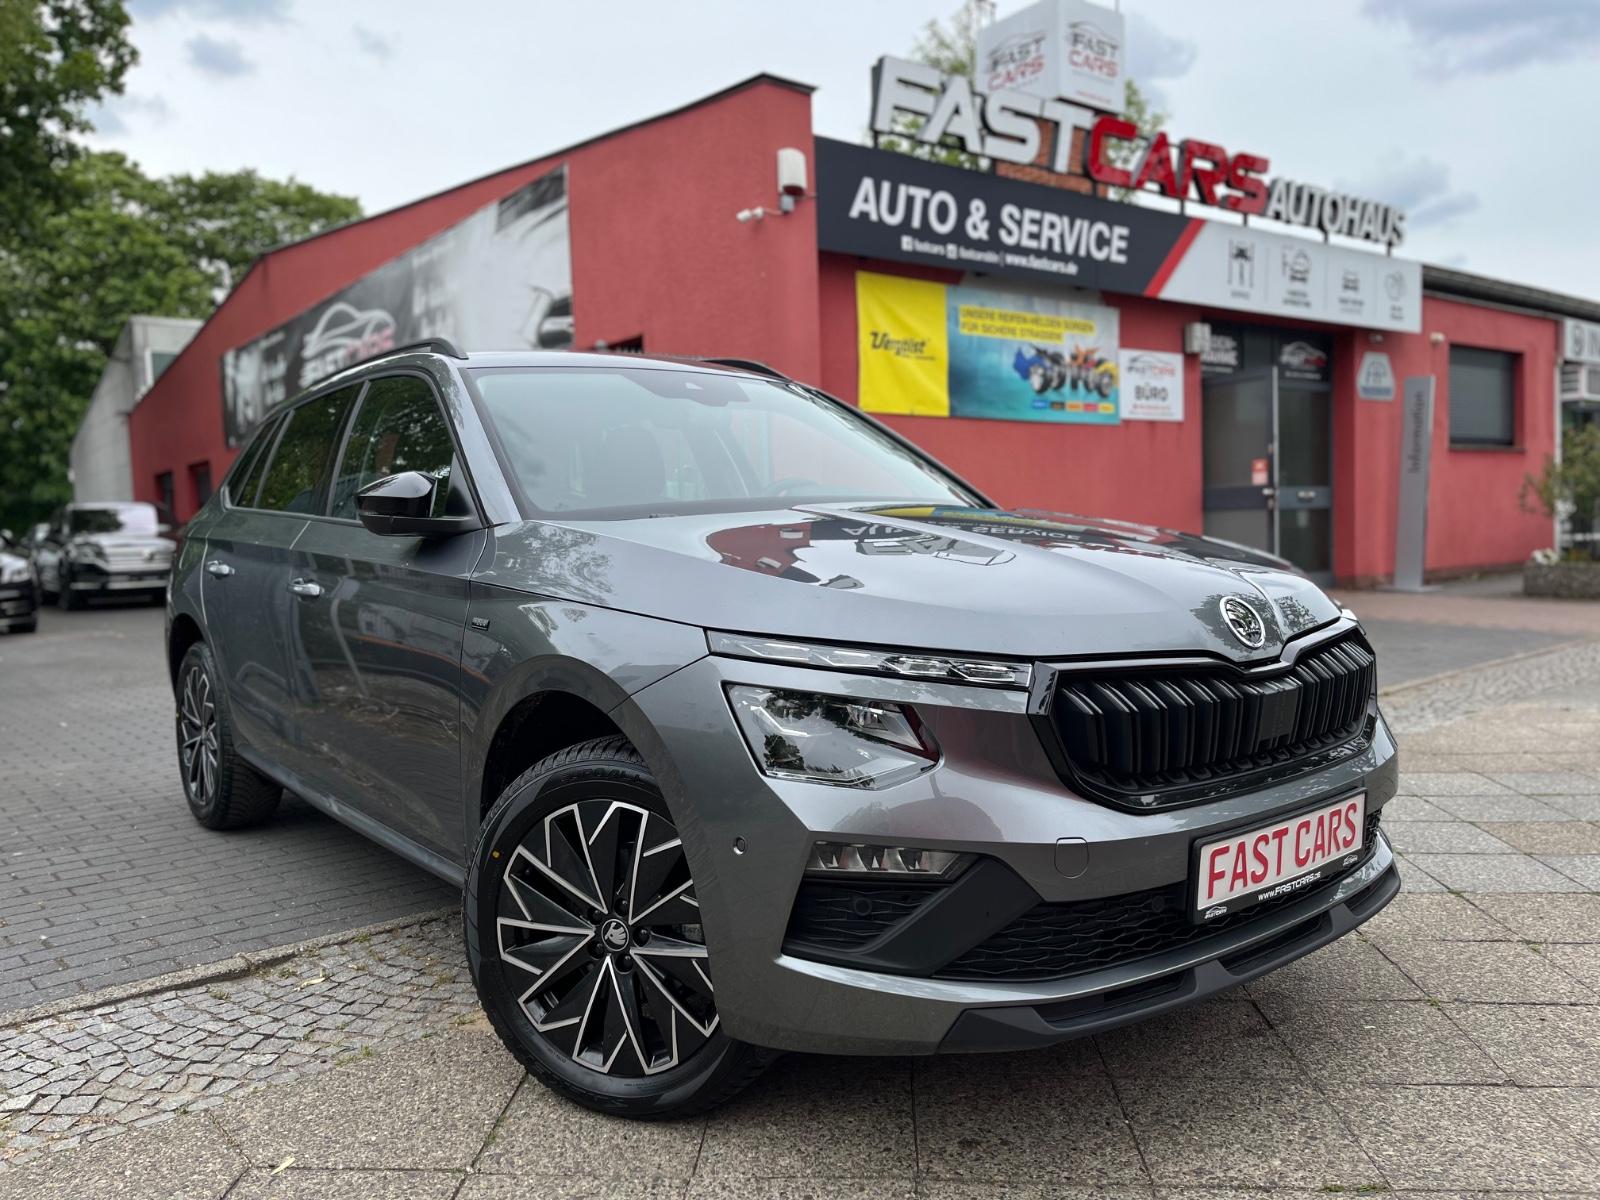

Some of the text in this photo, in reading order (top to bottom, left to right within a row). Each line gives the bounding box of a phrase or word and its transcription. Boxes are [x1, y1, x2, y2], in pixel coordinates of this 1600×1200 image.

[1068, 50, 1118, 79] CARS
[1072, 31, 1119, 58] FAST
[849, 176, 1130, 264] AUTO & SERVICE
[1266, 178, 1406, 246] AUTOHAUS
[1135, 381, 1168, 402] BÜRO
[1207, 802, 1357, 899] FAST CARS
